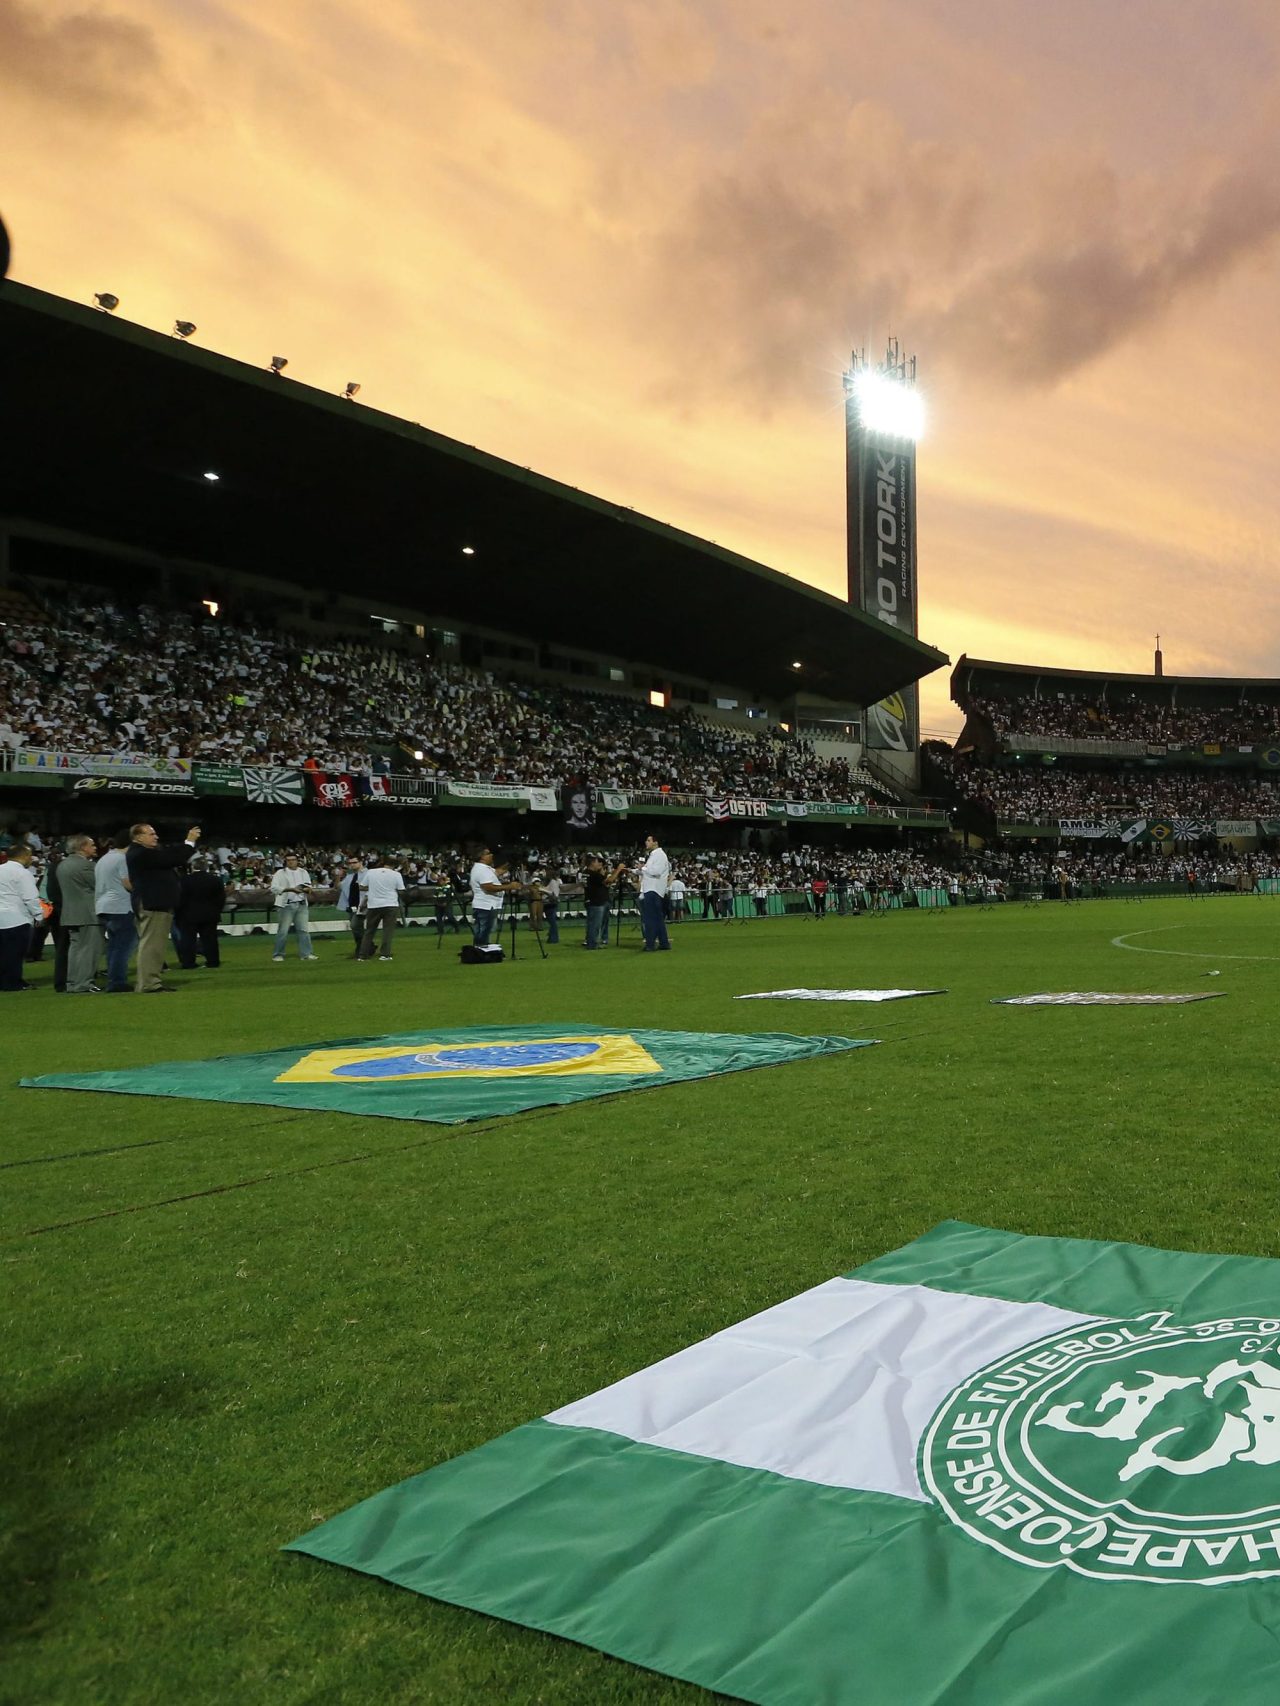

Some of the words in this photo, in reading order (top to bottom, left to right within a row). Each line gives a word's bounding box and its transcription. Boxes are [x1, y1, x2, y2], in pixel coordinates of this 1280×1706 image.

[877, 454, 897, 569] TORK
[877, 577, 897, 626] RO
[107, 781, 146, 791] PRO
[149, 783, 195, 793] TORK
[370, 795, 398, 803] PRO
[399, 796, 433, 804] TORK
[1195, 1322, 1235, 1336] SC
[968, 1325, 1149, 1404] FUTEBOL
[948, 1410, 997, 1449] DE
